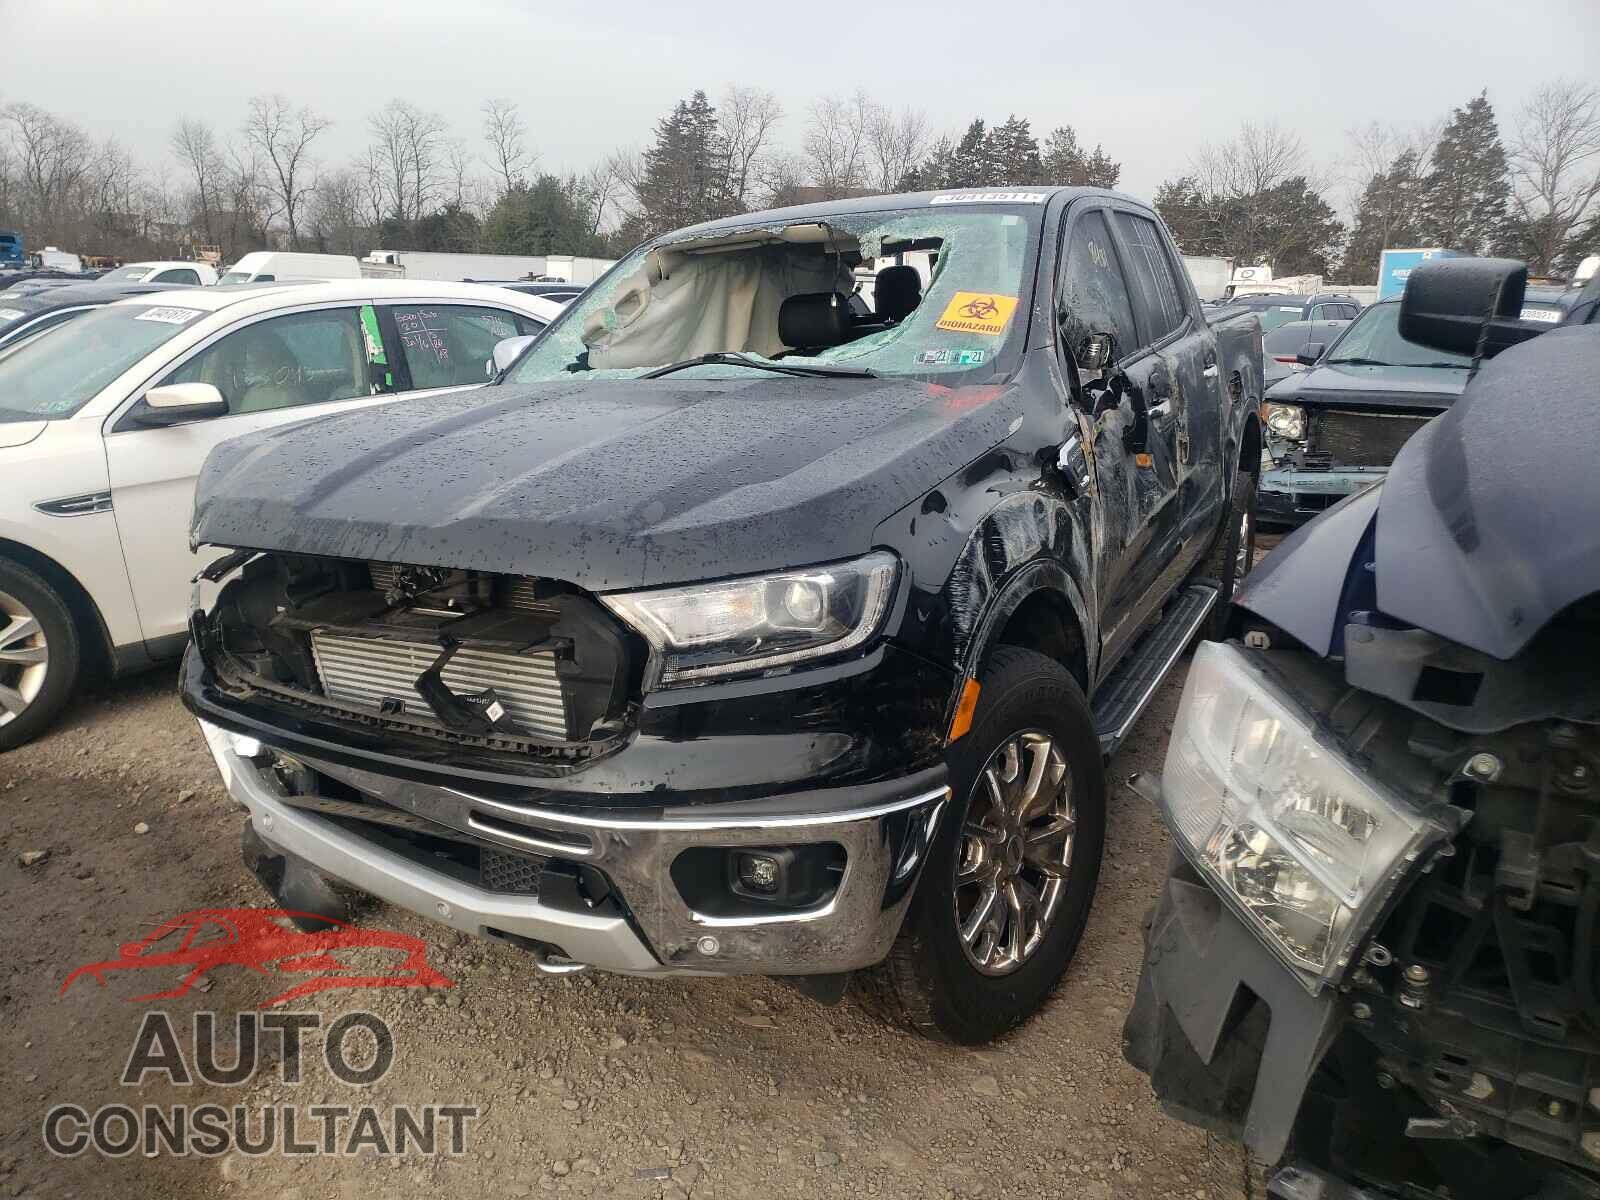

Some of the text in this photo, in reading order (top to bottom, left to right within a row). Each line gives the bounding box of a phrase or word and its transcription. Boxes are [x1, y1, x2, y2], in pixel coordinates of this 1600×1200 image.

[939, 320, 1002, 333] BIOHAZARD
[935, 350, 946, 361] 21
[971, 351, 982, 362] 21
